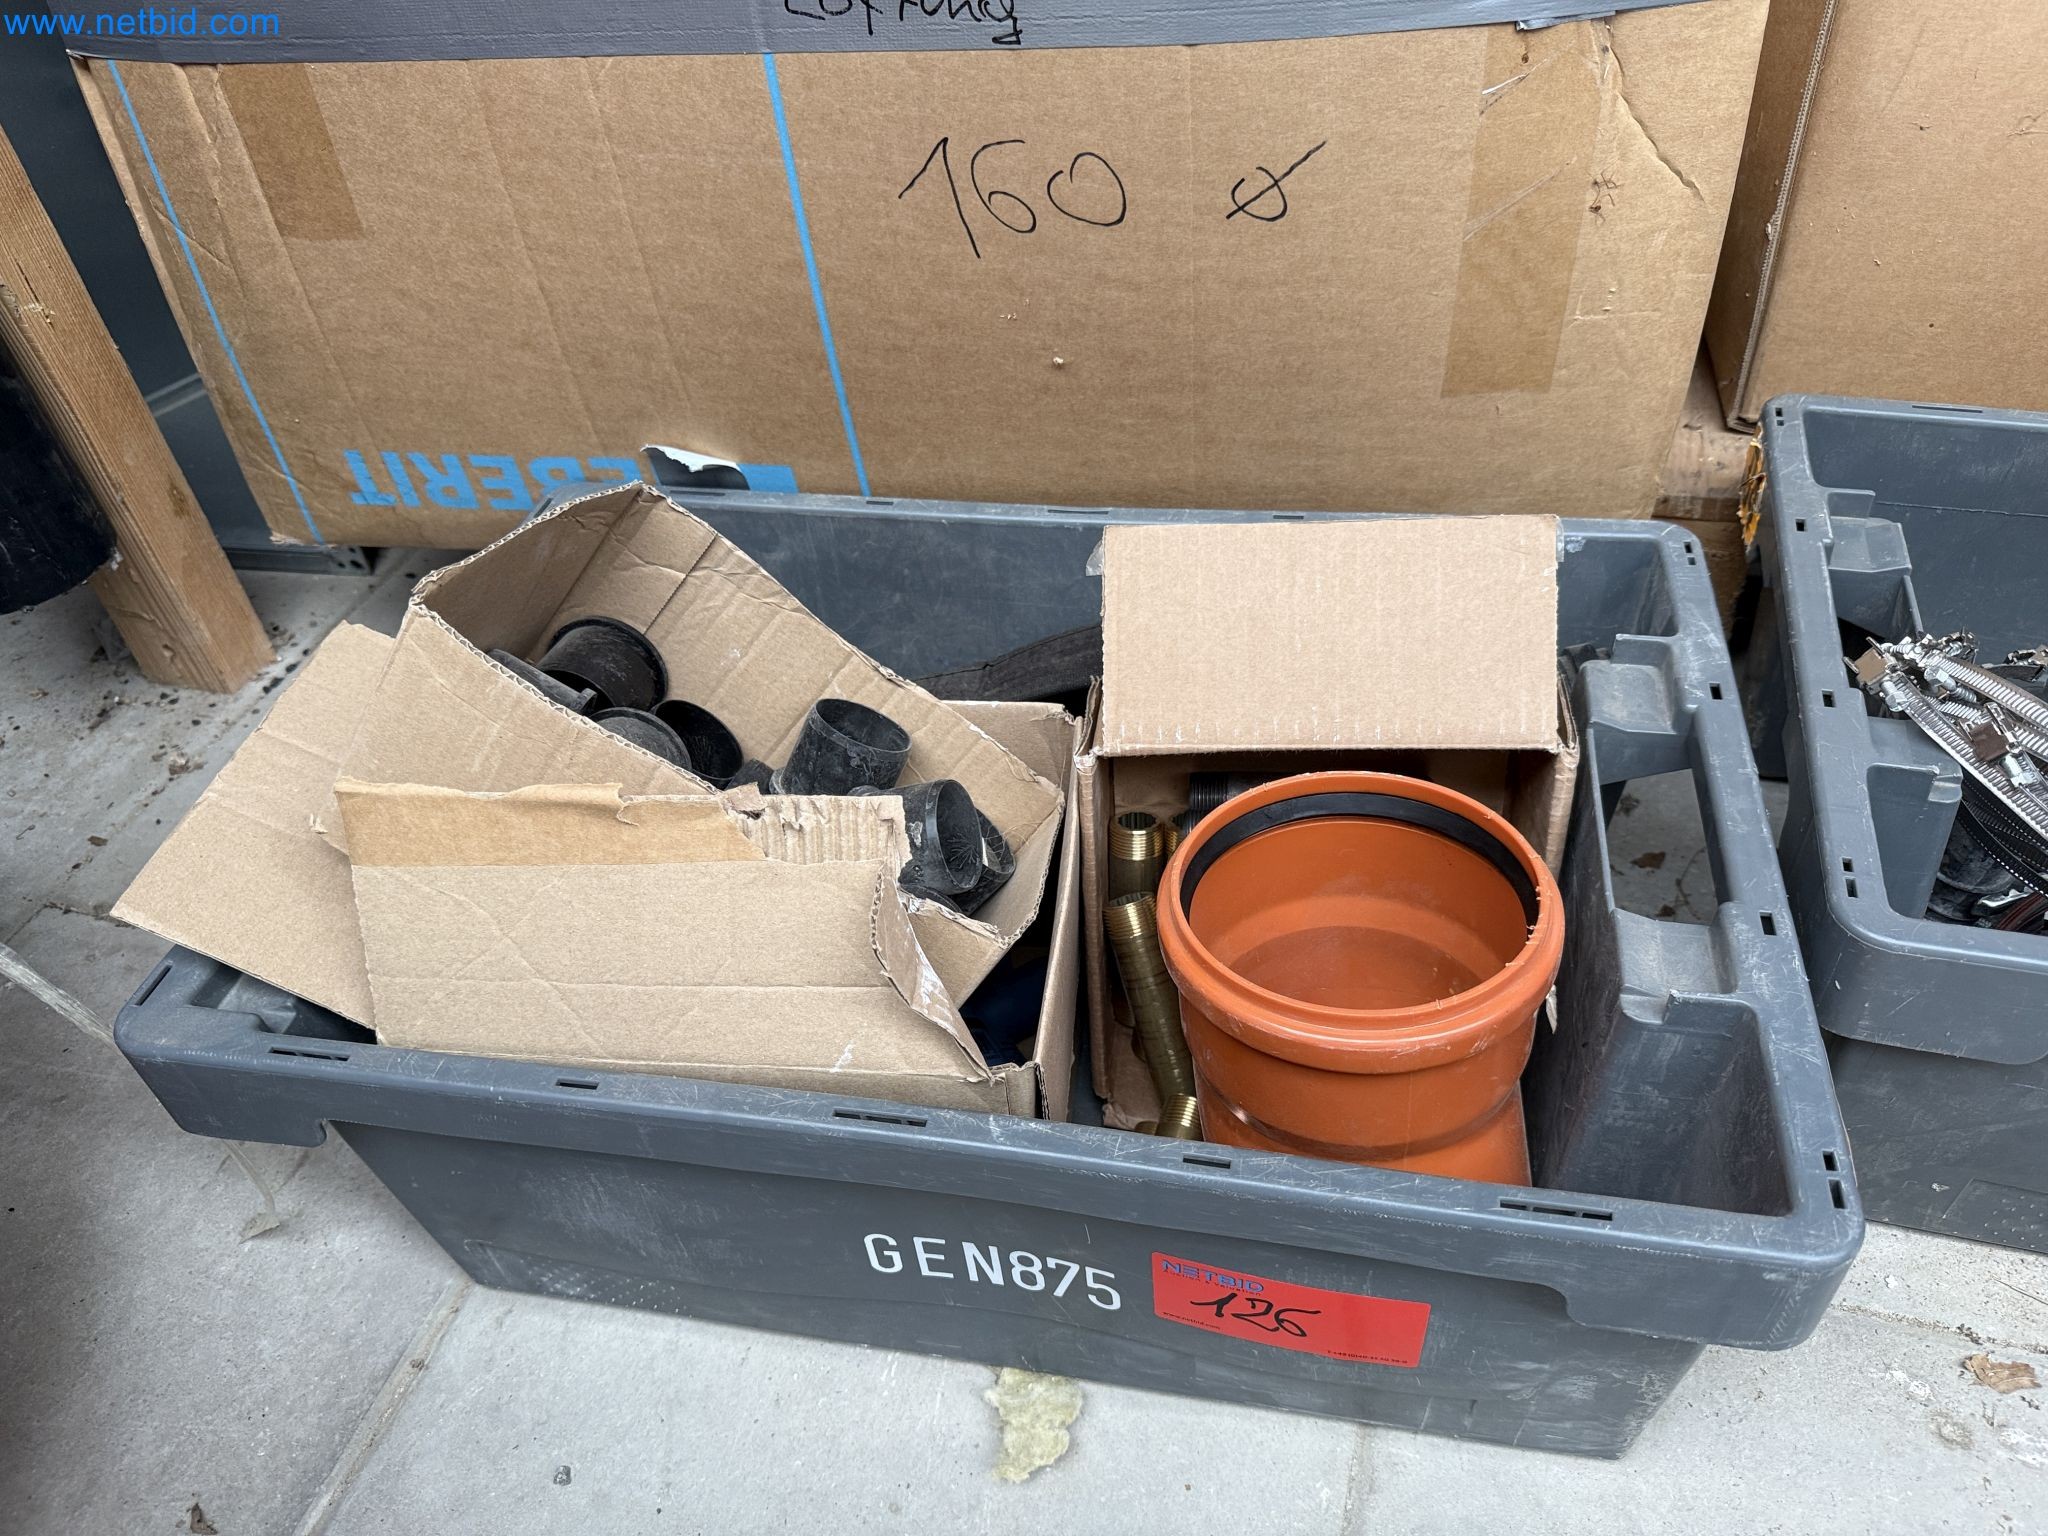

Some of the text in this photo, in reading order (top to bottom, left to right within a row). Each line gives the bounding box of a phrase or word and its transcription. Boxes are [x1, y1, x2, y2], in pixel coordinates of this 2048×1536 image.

[898, 136, 1127, 259] 160
[343, 449, 655, 511] EBERIT
[863, 1232, 1122, 1311] GEN875
[1161, 1259, 1264, 1293] NETBID
[1189, 1292, 1322, 1338] 126
